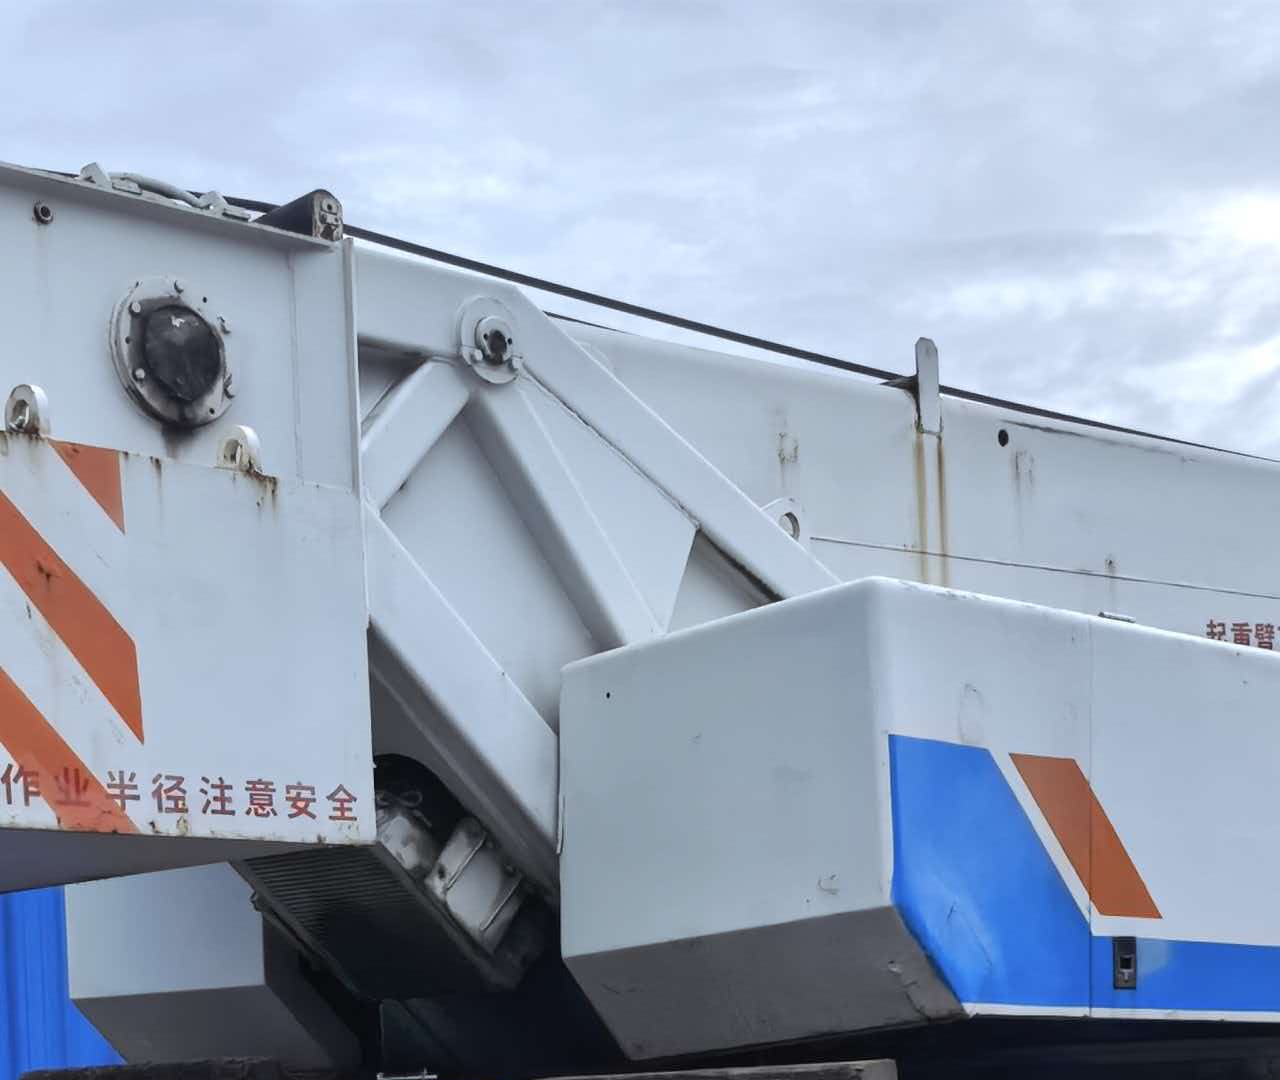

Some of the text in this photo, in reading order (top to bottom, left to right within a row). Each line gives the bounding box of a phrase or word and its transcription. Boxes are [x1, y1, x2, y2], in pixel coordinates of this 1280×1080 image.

[0, 763, 359, 823] 作业半径注意安全
